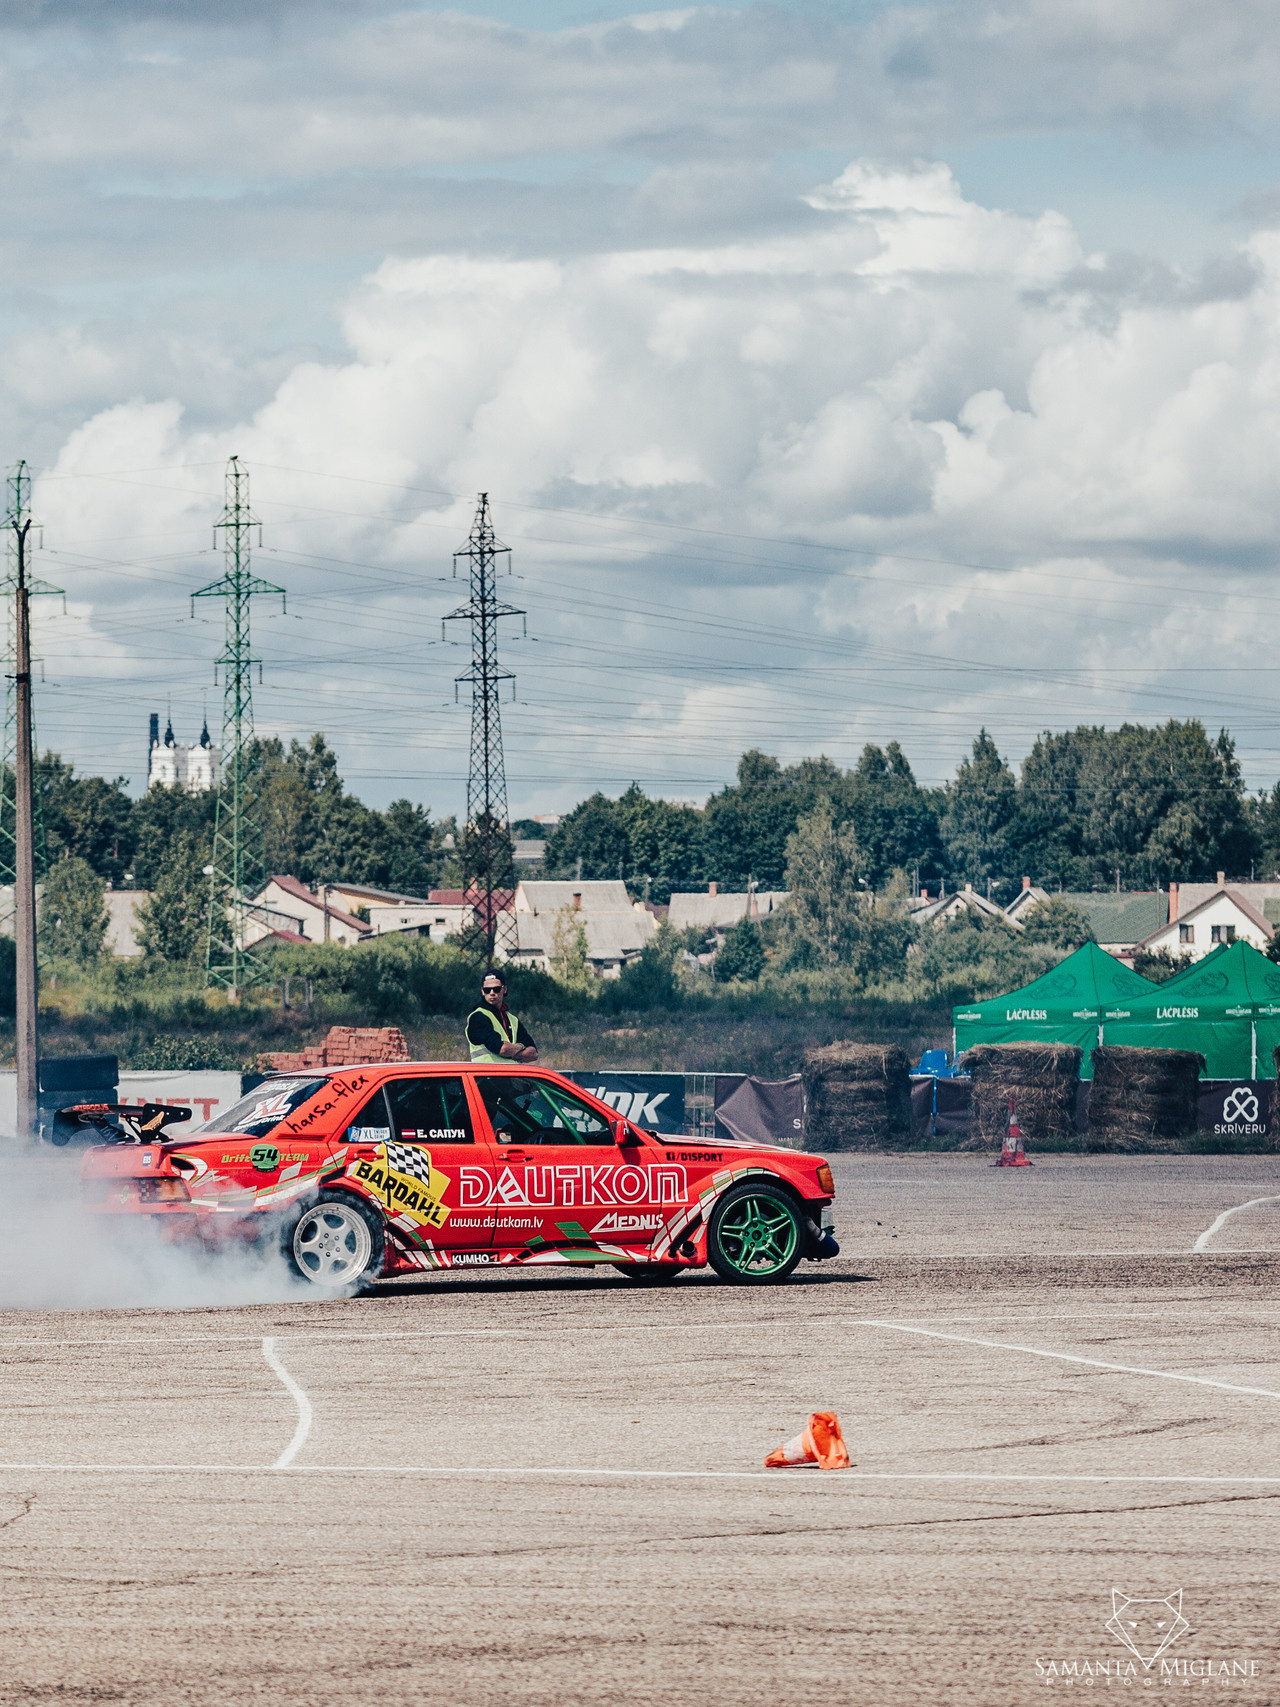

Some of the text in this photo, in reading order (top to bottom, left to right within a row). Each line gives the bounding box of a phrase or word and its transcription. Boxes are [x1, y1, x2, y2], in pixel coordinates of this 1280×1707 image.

[285, 1075, 369, 1133] hansa-flex
[252, 1149, 278, 1162] 54
[279, 1153, 310, 1162] TEAM
[356, 1161, 442, 1225] BARDAHL
[401, 1177, 437, 1202] WORLD FAMOUS
[450, 1216, 544, 1229] www.dautkom.lv
[452, 1254, 490, 1264] KUMHO
